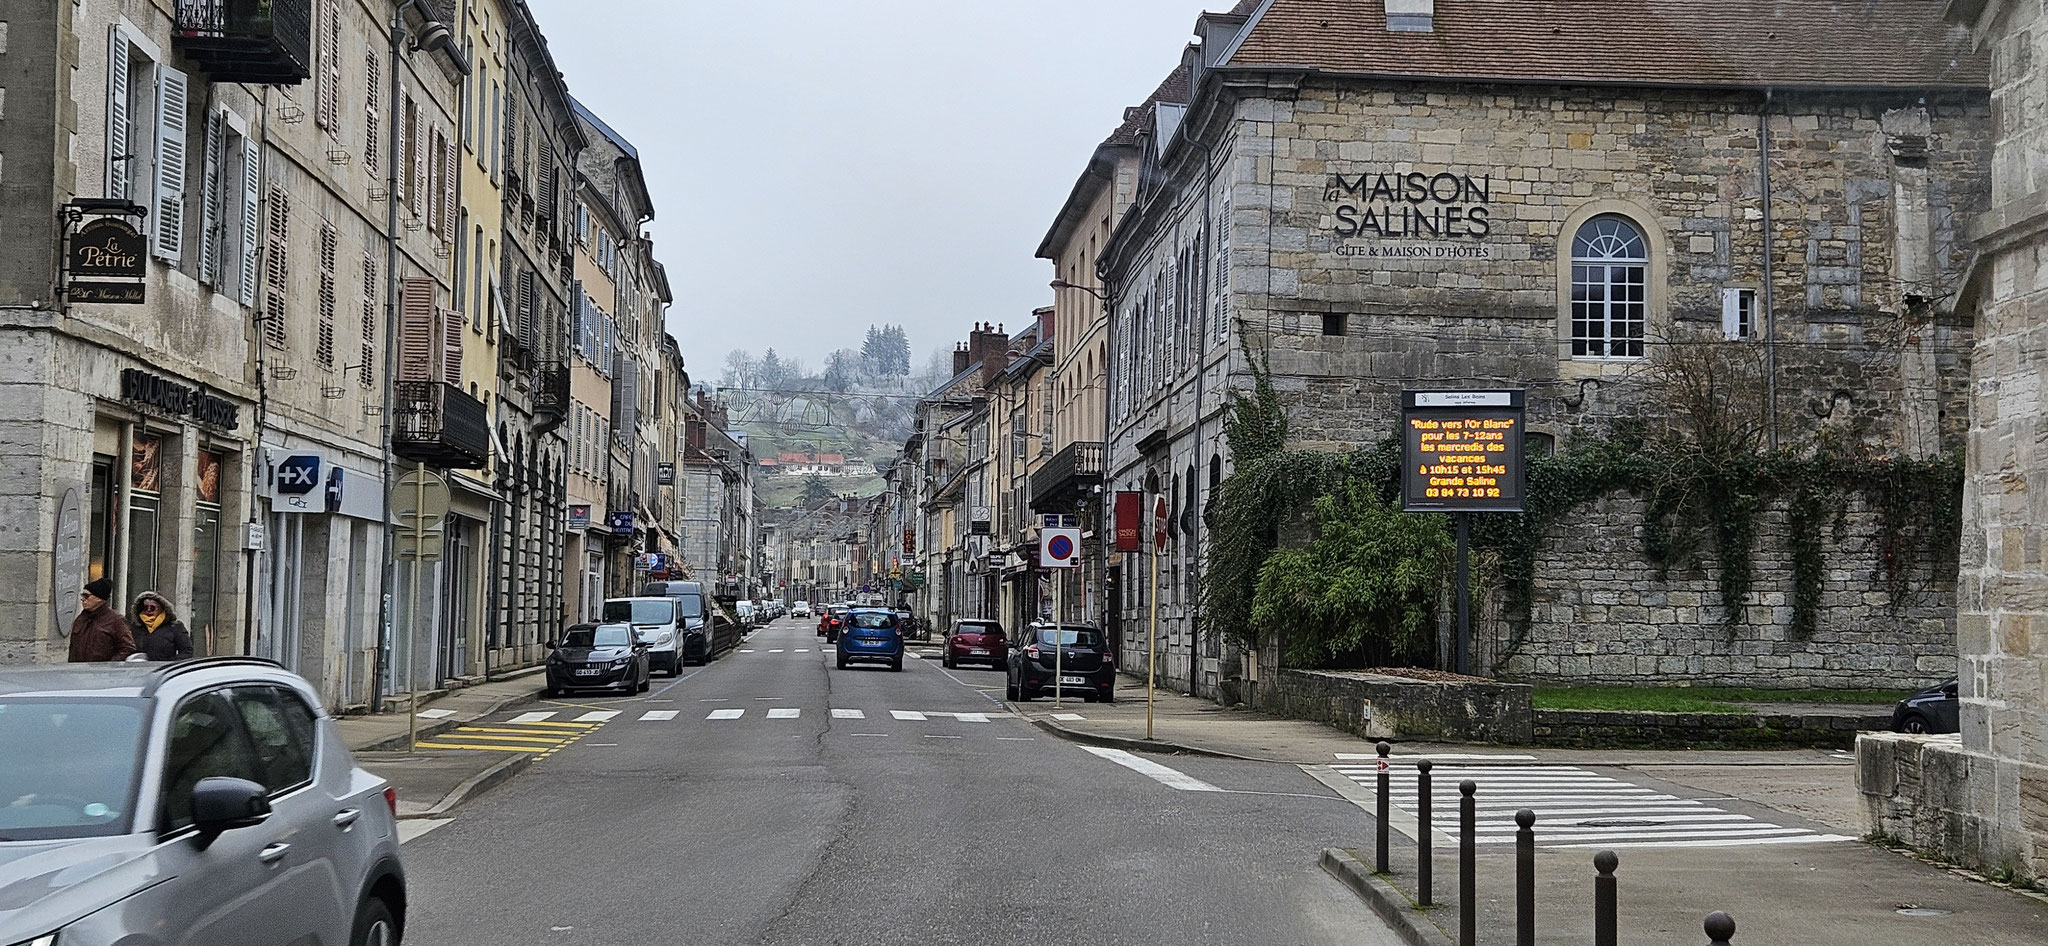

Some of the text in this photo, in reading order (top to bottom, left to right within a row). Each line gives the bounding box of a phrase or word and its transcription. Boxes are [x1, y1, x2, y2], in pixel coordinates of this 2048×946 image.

[1322, 172, 1490, 204] la MAISON
[1334, 205, 1490, 238] SALINES
[102, 237, 122, 253] La
[1336, 244, 1489, 257] GÎTE & MAISON D'HÔTES
[79, 246, 136, 268] Pétrie
[1411, 419, 1514, 429] "Ruée vers l'Or Blanc"
[1422, 431, 1503, 442] pour les 7-12ans
[1420, 443, 1504, 452] les mercredis des
[1439, 455, 1486, 463] vacances
[1419, 465, 1505, 474] à 10h15 et 15h45
[1429, 477, 1496, 486] Grande Saline
[1426, 488, 1500, 497] 03 84 73 10 92
[1156, 516, 1166, 533] STOP
